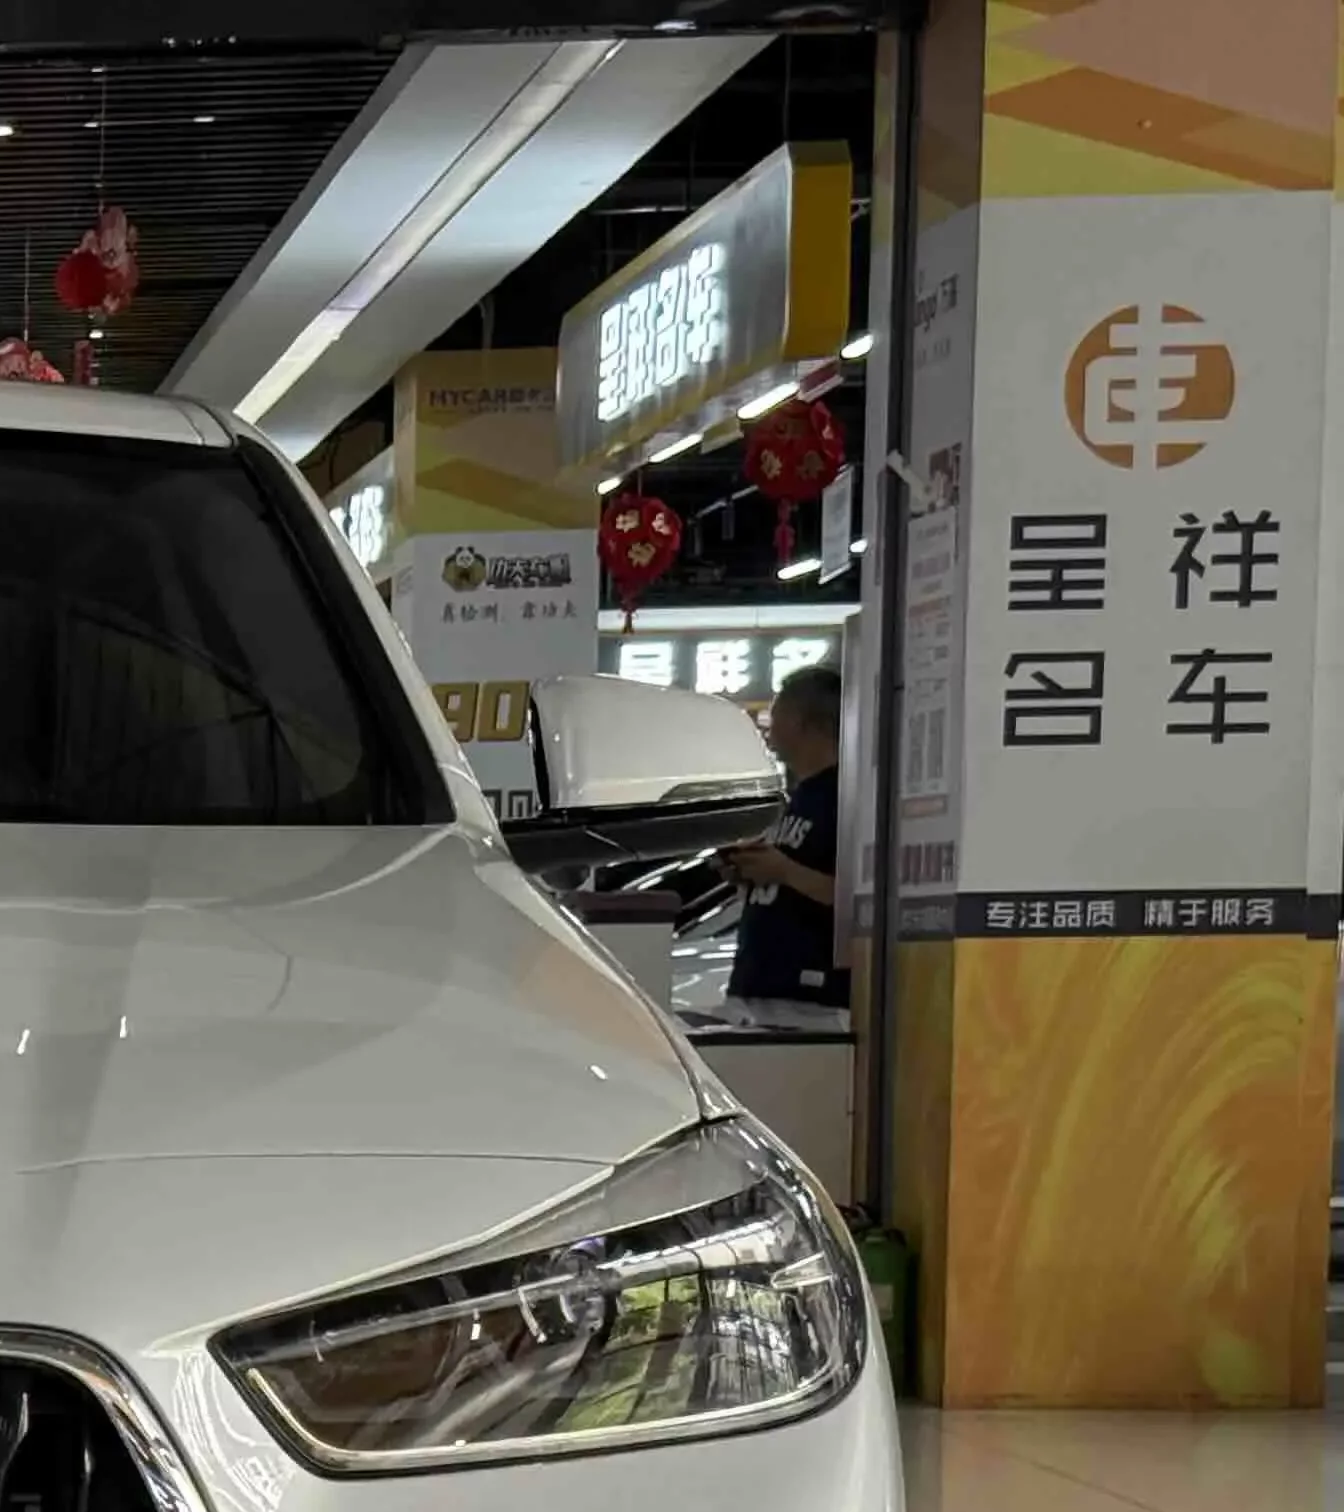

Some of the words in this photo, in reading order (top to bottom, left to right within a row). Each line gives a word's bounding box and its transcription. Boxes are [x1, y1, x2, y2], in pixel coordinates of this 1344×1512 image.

[1008, 510, 1280, 611] 呈祥
[1003, 649, 1273, 747] 名车
[986, 899, 1116, 930] 专注品质
[1144, 897, 1275, 929] 精于服务
